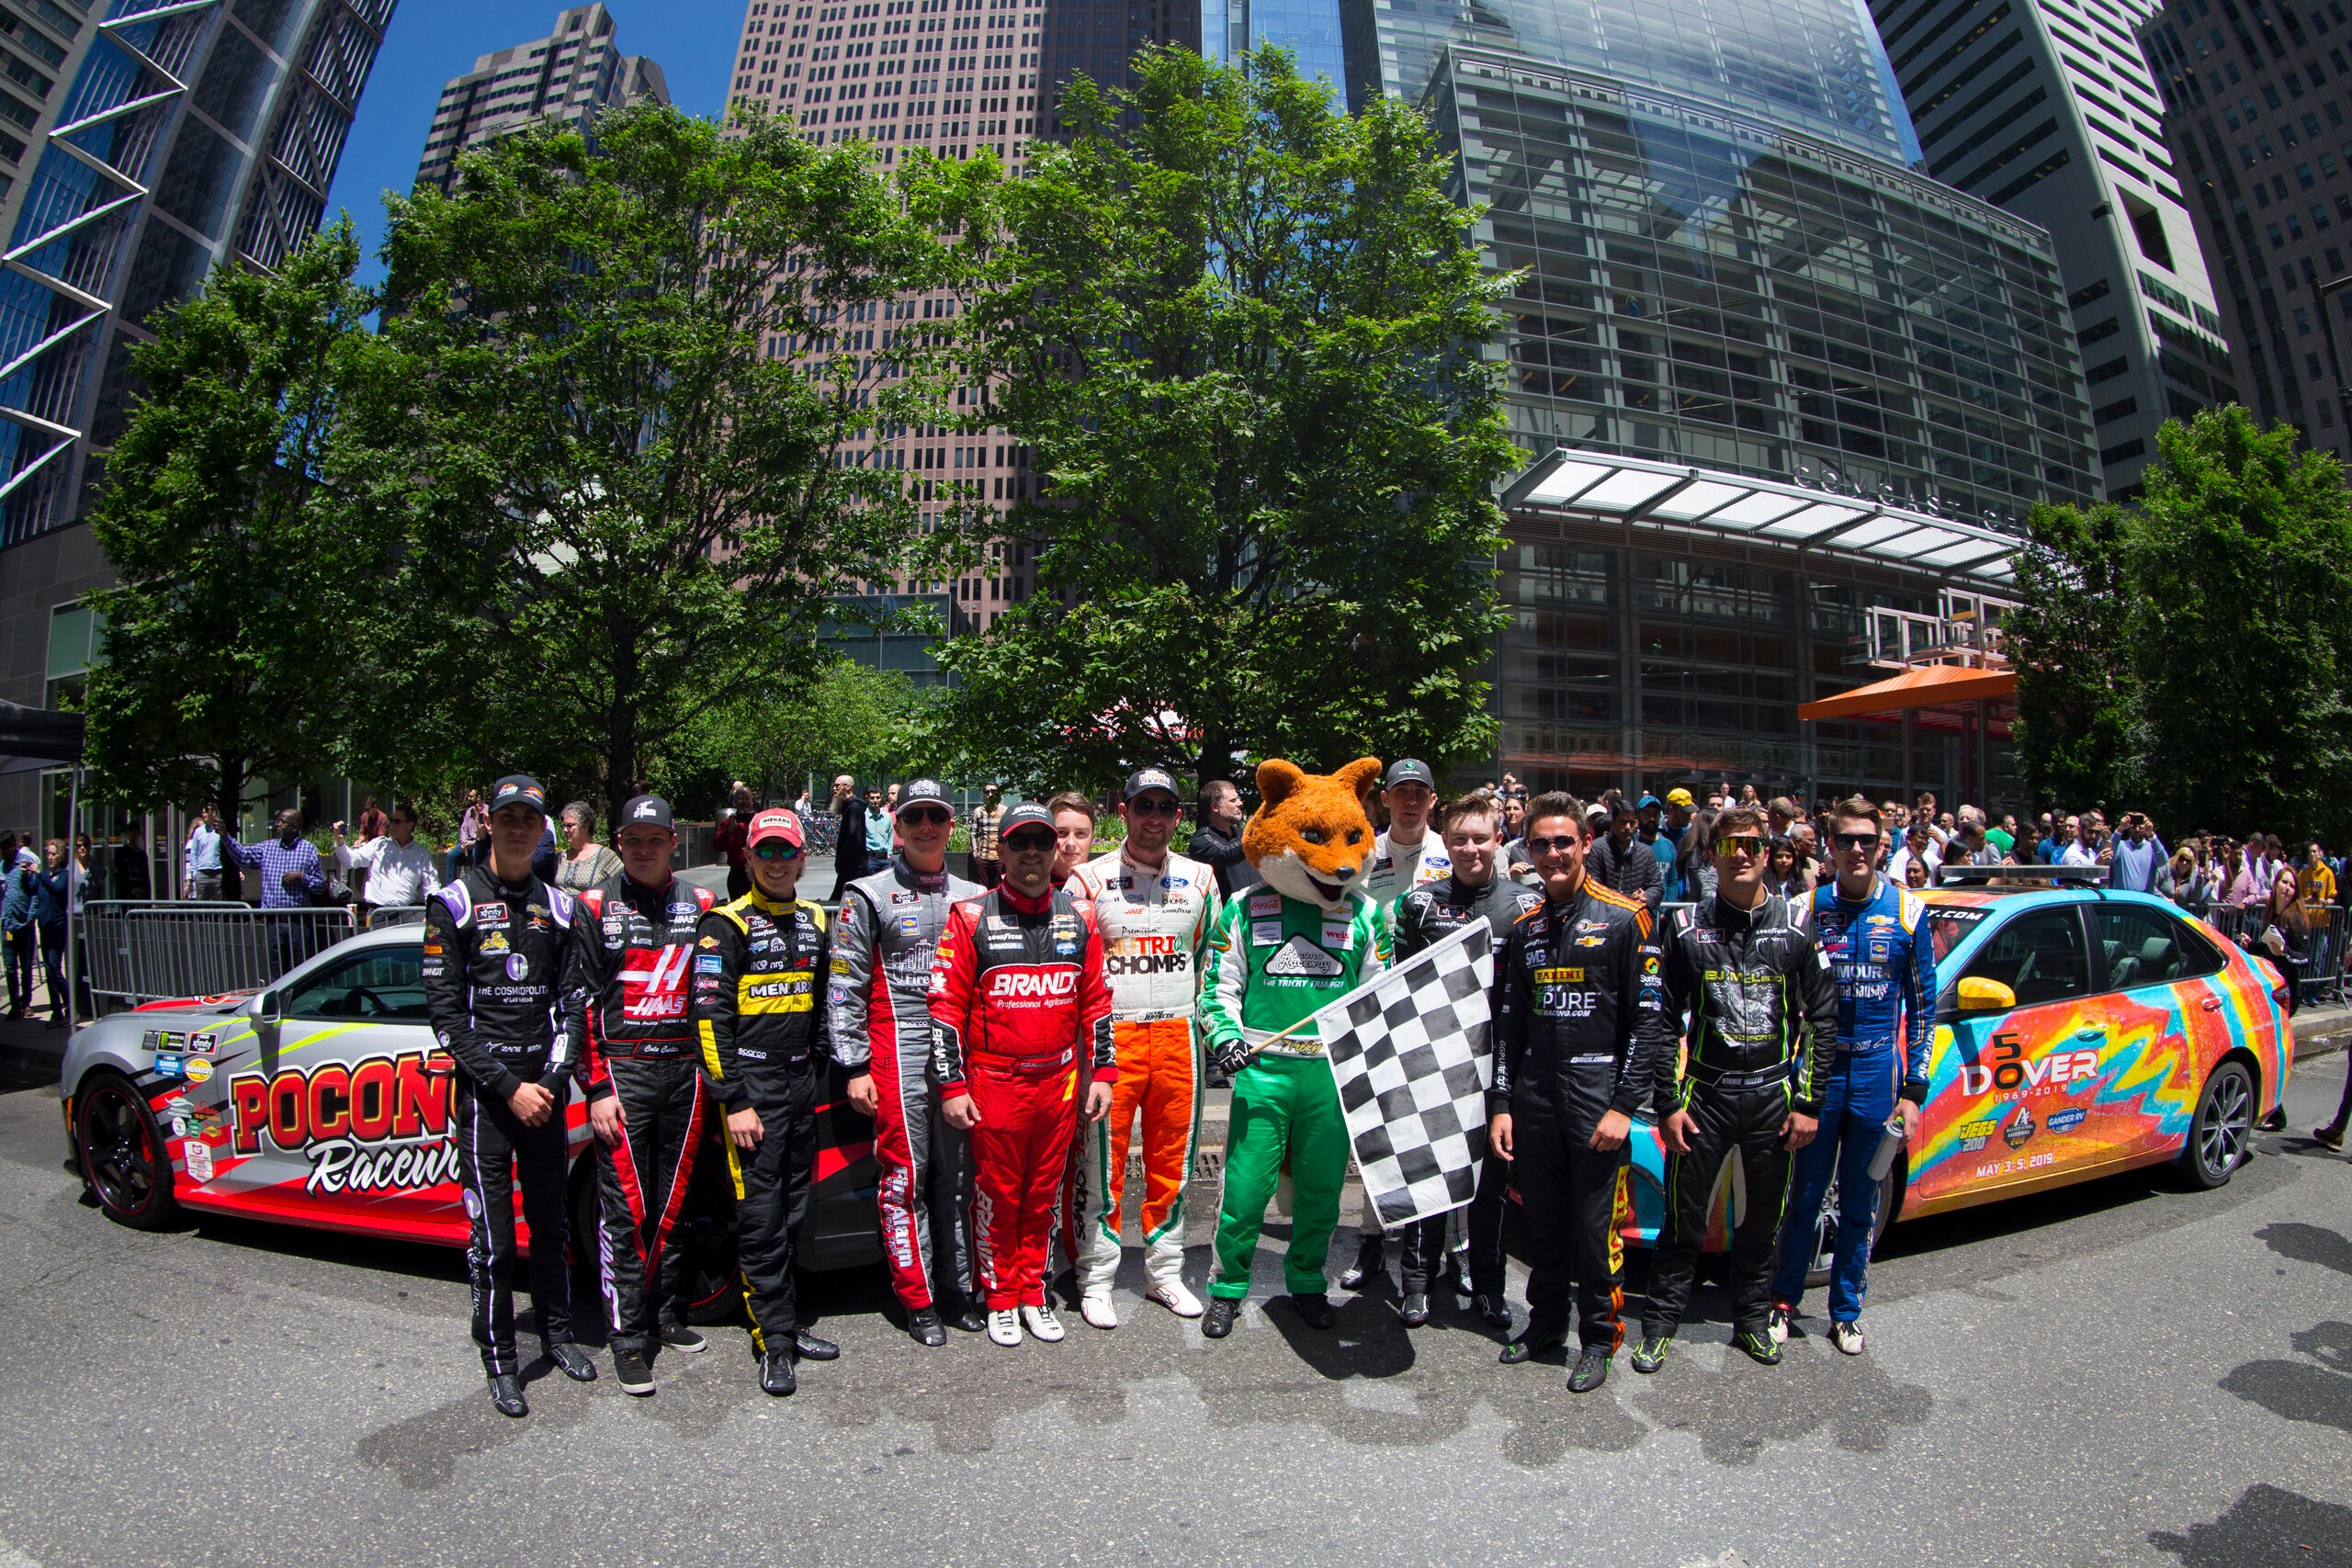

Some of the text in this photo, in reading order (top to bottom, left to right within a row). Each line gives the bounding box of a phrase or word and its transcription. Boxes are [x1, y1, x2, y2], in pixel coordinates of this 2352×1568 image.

[1793, 464, 1961, 522] COMCAST
[1012, 805, 1047, 816] BRANDT
[1110, 880, 1129, 888] xfinity
[1165, 877, 1185, 886] Ford
[895, 894, 915, 903] xfinity
[481, 908, 502, 919] xfinity
[672, 904, 691, 912] Ford
[892, 906, 923, 914] GOODYEAR
[669, 916, 698, 924] HAAS
[1926, 909, 1984, 921] Y.COM
[752, 928, 778, 937] GOODYEAR
[1122, 925, 1159, 936] Premium
[1326, 931, 1350, 940] weis
[1756, 927, 1789, 935] GOODYEAR
[988, 932, 1023, 942] GOODYEAR
[1286, 946, 1325, 960] Pocono
[1525, 949, 1547, 966] SMG
[770, 960, 785, 970] nrg
[831, 959, 849, 970] ROMCO
[1106, 953, 1187, 976] CHOMPS
[1276, 955, 1331, 974] Raceway
[1537, 969, 1582, 981] PANINI
[1704, 970, 1724, 980] BJ
[1831, 964, 1884, 979] RMOUR
[905, 974, 930, 985] Fire
[989, 971, 1082, 997] BRANDT
[1263, 979, 1345, 988] THE TRICKY TRIANGLE
[479, 986, 492, 996] THE
[1852, 982, 1889, 1001] Sausage
[624, 995, 687, 1017] HAAS
[997, 997, 1075, 1010] Professional Agriculture
[1543, 991, 1597, 1010] PURE
[1543, 1009, 1591, 1018] RACING.COM
[899, 1021, 929, 1029] sparco
[644, 1043, 660, 1053] Cole
[738, 1047, 767, 1059] sparco
[185, 1065, 214, 1076] MENARDS
[1960, 1052, 2099, 1097] DOVER
[1062, 1068, 1078, 1101] 1
[1721, 1077, 1744, 1086] VINNIE
[1994, 1083, 2068, 1102] 1969-2019
[231, 1050, 458, 1156] POCON
[2048, 1111, 2086, 1127] GANDER RV
[1959, 1120, 1998, 1140] JEGS
[1962, 1135, 1986, 1153] 200
[2009, 1137, 2025, 1146] 200
[1976, 1162, 2001, 1179] MAY
[2029, 1152, 2053, 1168] 2019
[891, 1166, 914, 1269] Fire Alarm
[974, 1182, 997, 1290] BRANDT
